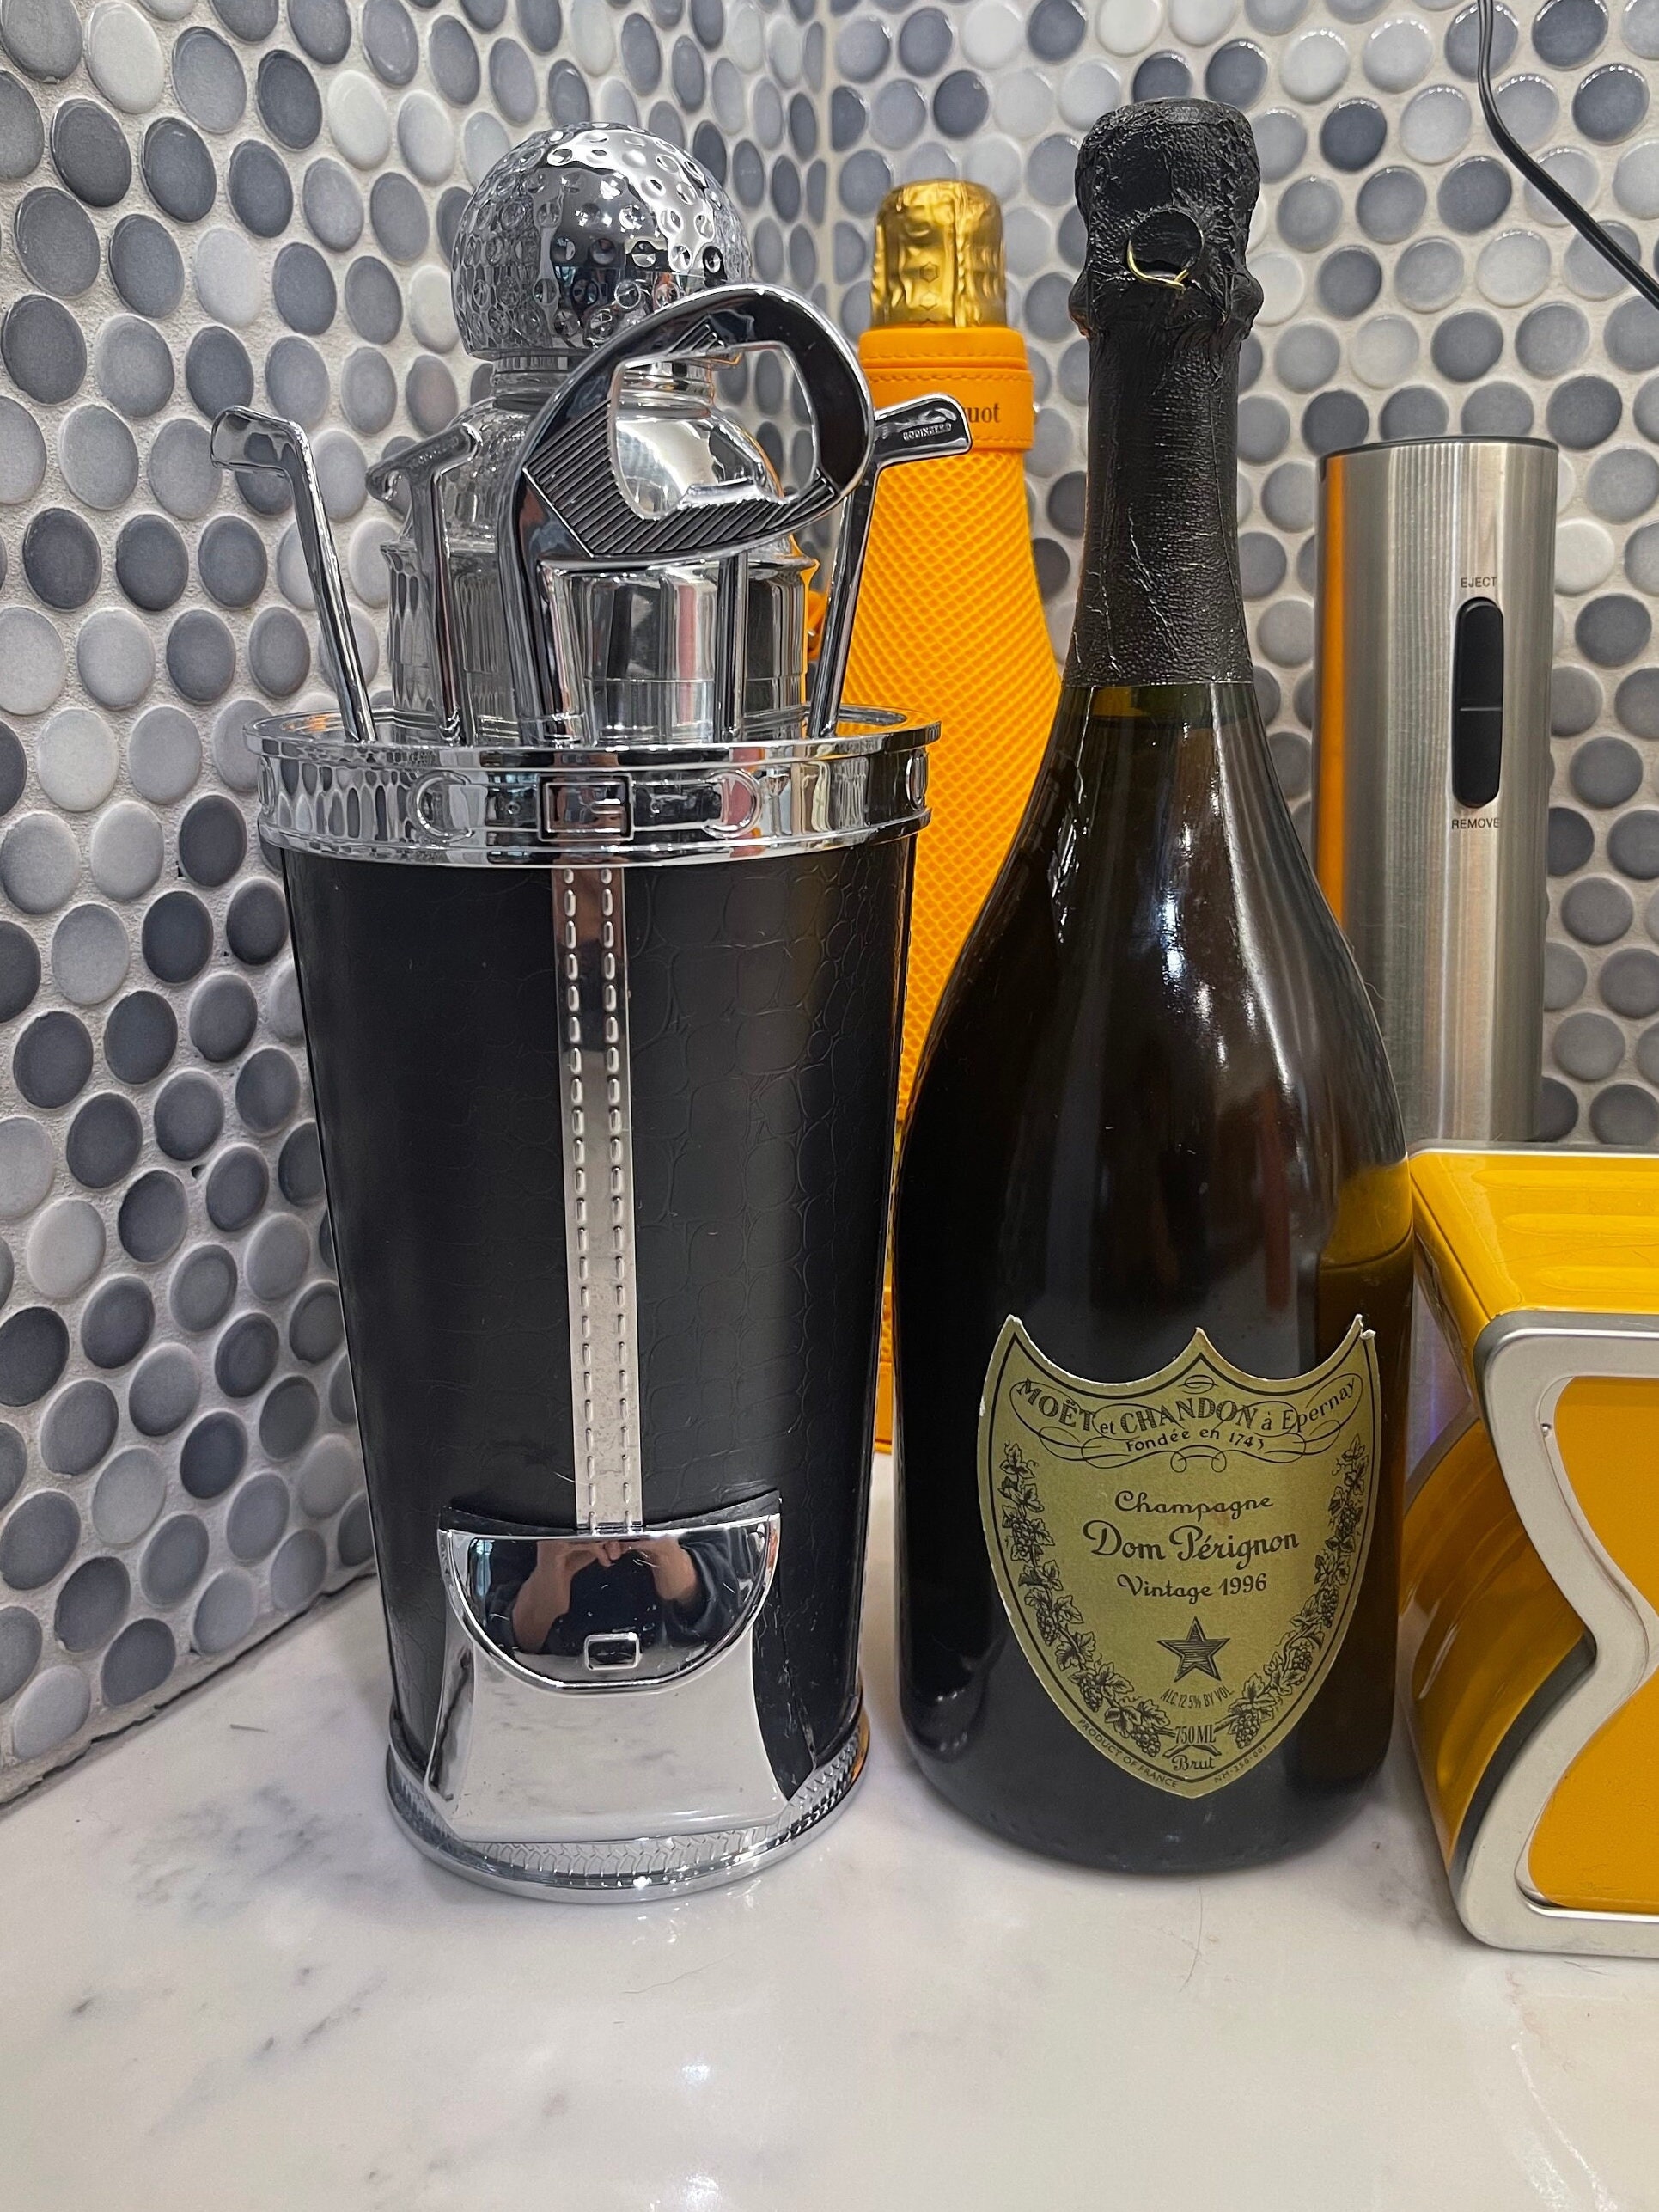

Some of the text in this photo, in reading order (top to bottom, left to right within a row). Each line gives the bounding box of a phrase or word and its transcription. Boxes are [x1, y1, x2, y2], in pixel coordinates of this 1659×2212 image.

[966, 403, 1000, 423] uot
[1460, 577, 1497, 588] EJECT
[1451, 816, 1500, 830] REMOVE
[1016, 1377, 1355, 1435] MOËT et CHANDON à Epernay
[1199, 1427, 1220, 1440] en
[1229, 1431, 1265, 1451] 1743
[1114, 1490, 1274, 1521] Champagne
[1083, 1519, 1300, 1570] Dom Pérignon
[1117, 1573, 1267, 1604] Vintage 1996
[1203, 1691, 1215, 1708] BY
[1078, 1719, 1179, 1788] PRODUCT OF FRANCE
[1171, 1754, 1216, 1771] Brut
